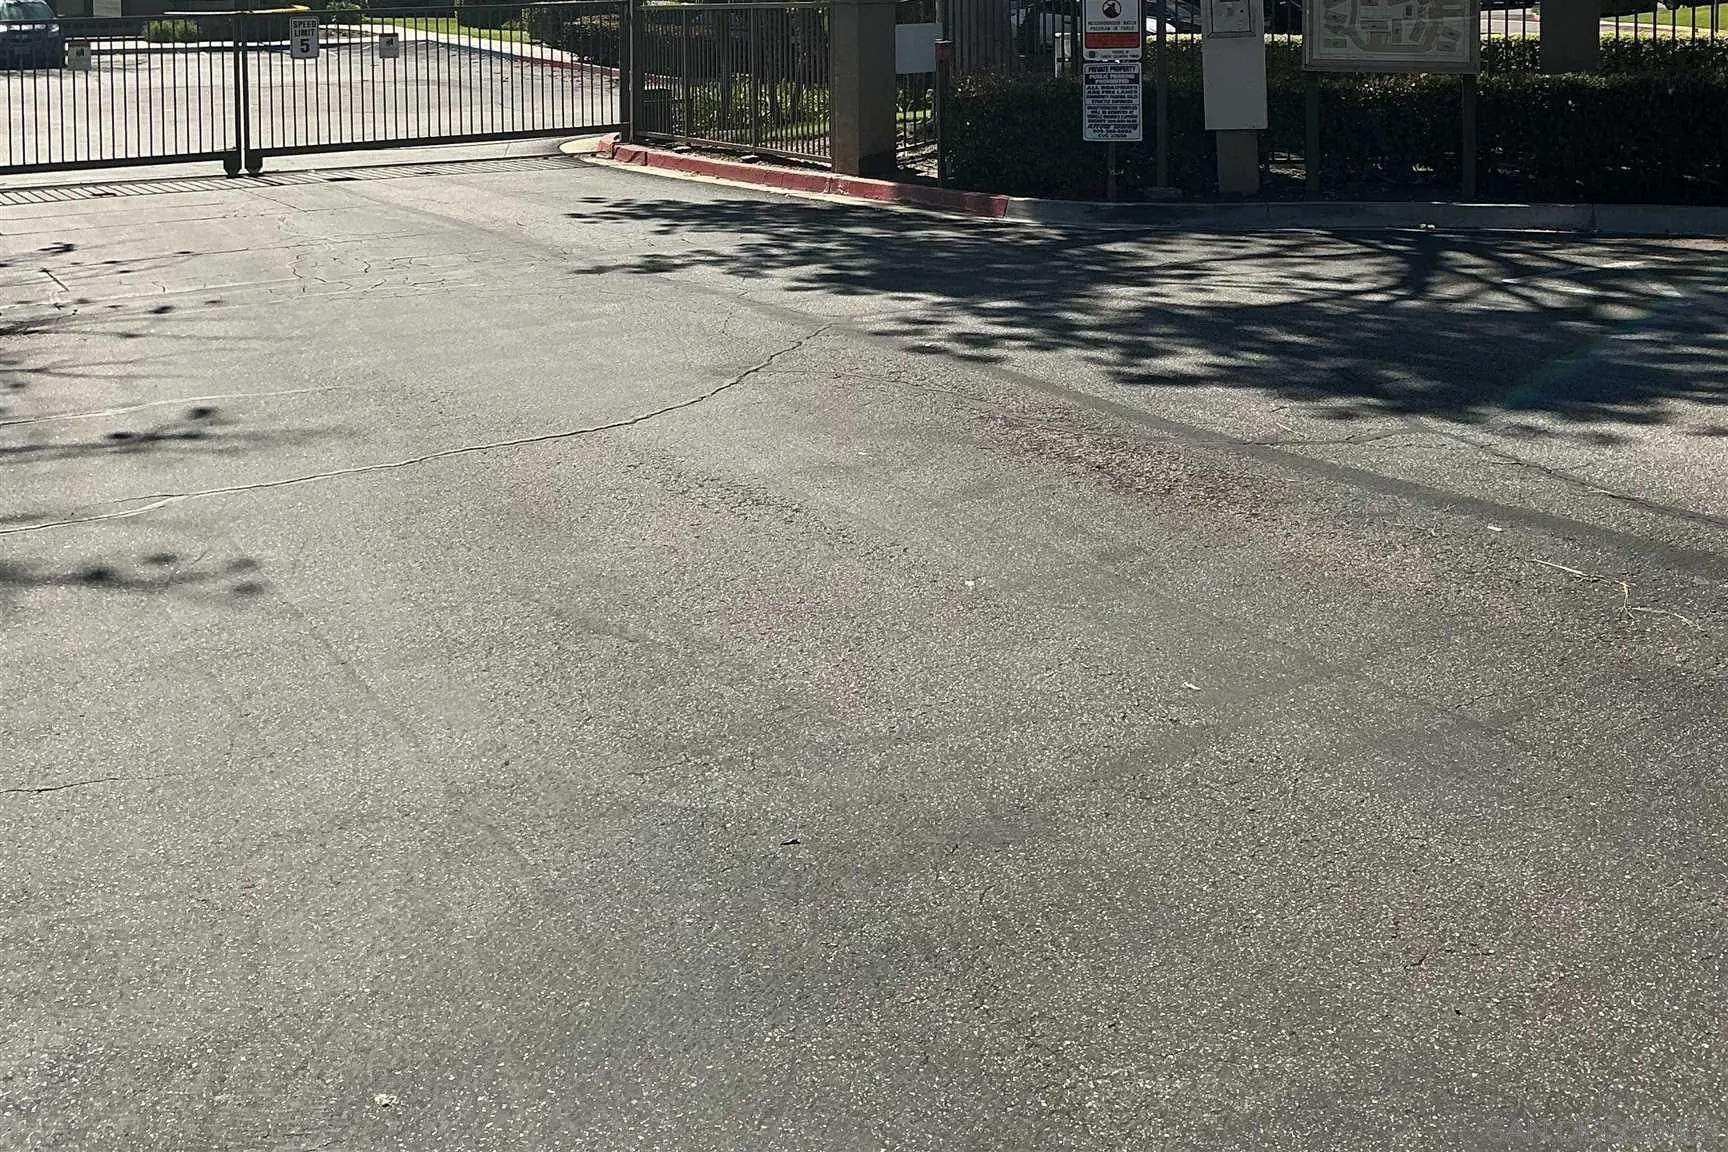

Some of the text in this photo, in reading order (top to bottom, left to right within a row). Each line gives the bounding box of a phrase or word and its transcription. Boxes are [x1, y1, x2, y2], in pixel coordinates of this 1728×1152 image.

[292, 20, 317, 28] SPEED
[294, 28, 316, 37] LIMIT
[300, 38, 311, 53] 5
